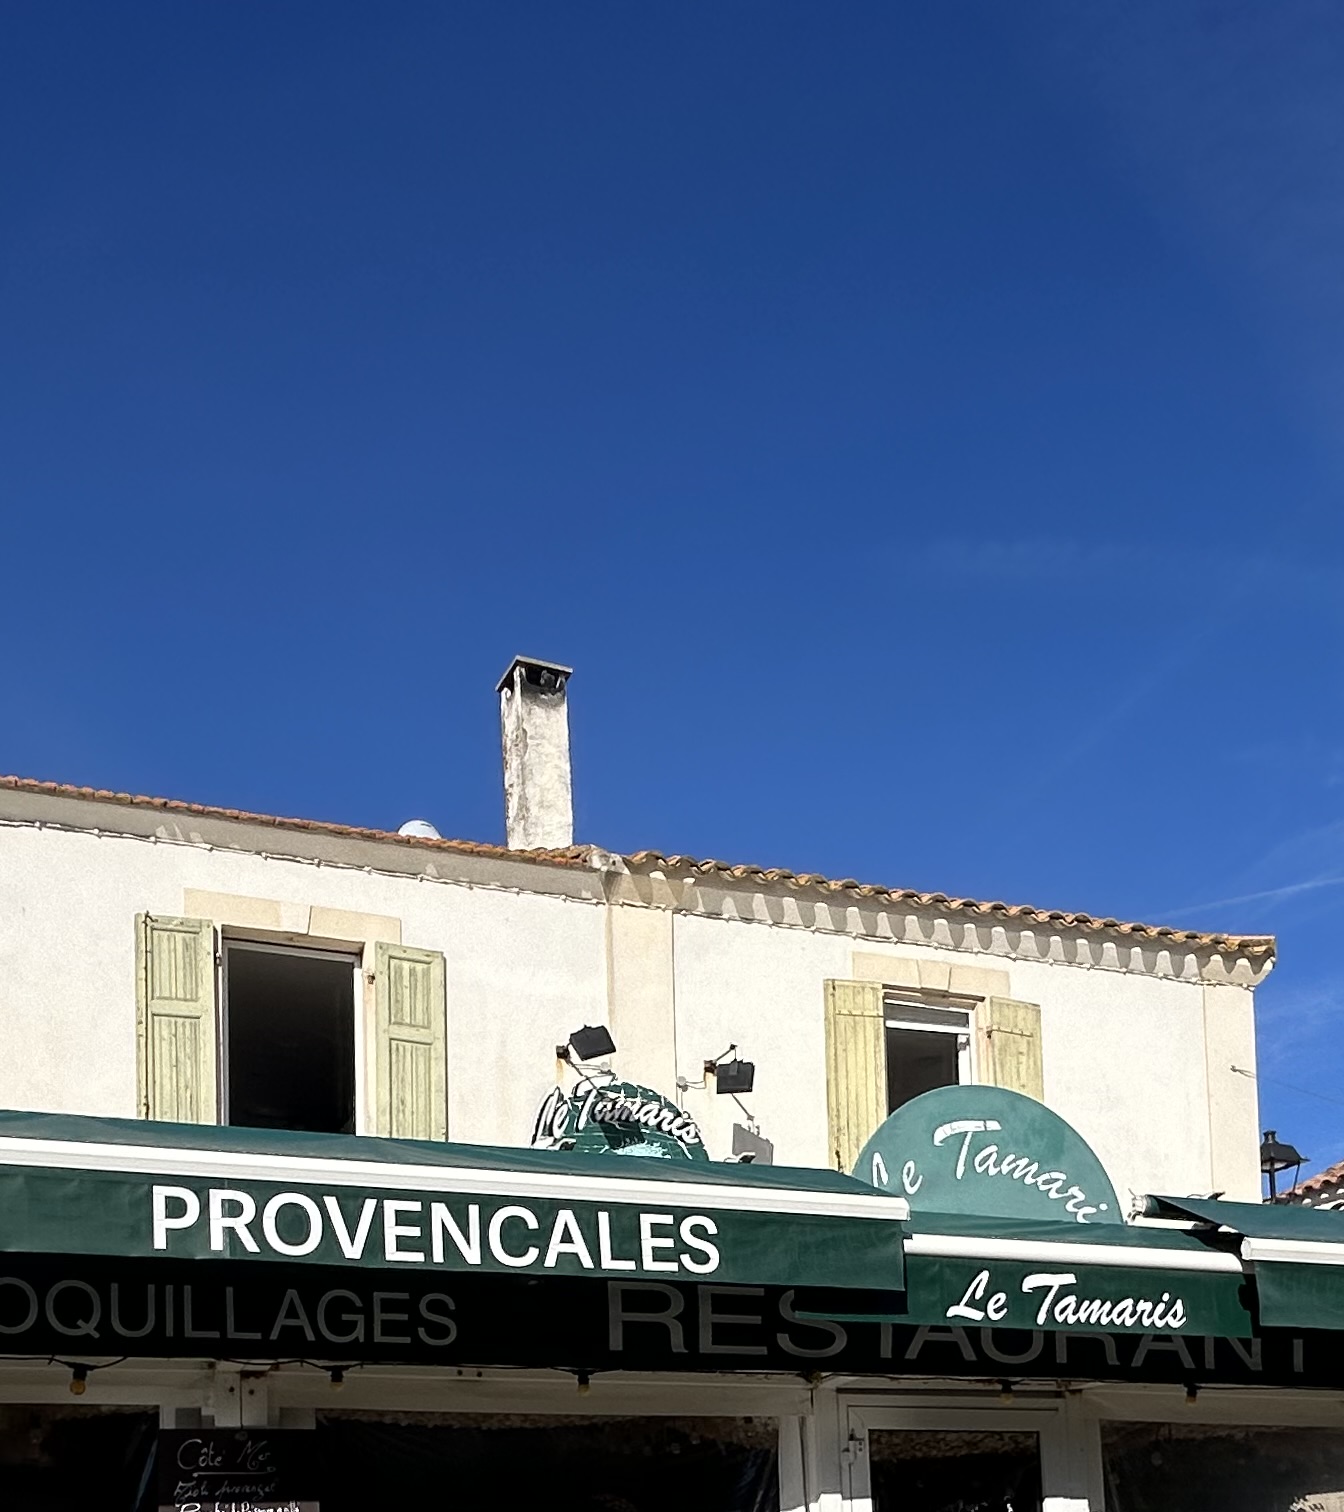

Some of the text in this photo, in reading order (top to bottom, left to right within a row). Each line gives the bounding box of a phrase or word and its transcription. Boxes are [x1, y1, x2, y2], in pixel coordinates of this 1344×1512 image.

[572, 1075, 701, 1145] Tamaris
[151, 1184, 722, 1275] PROVENCALES
[946, 1269, 1188, 1330] Le Tamaris
